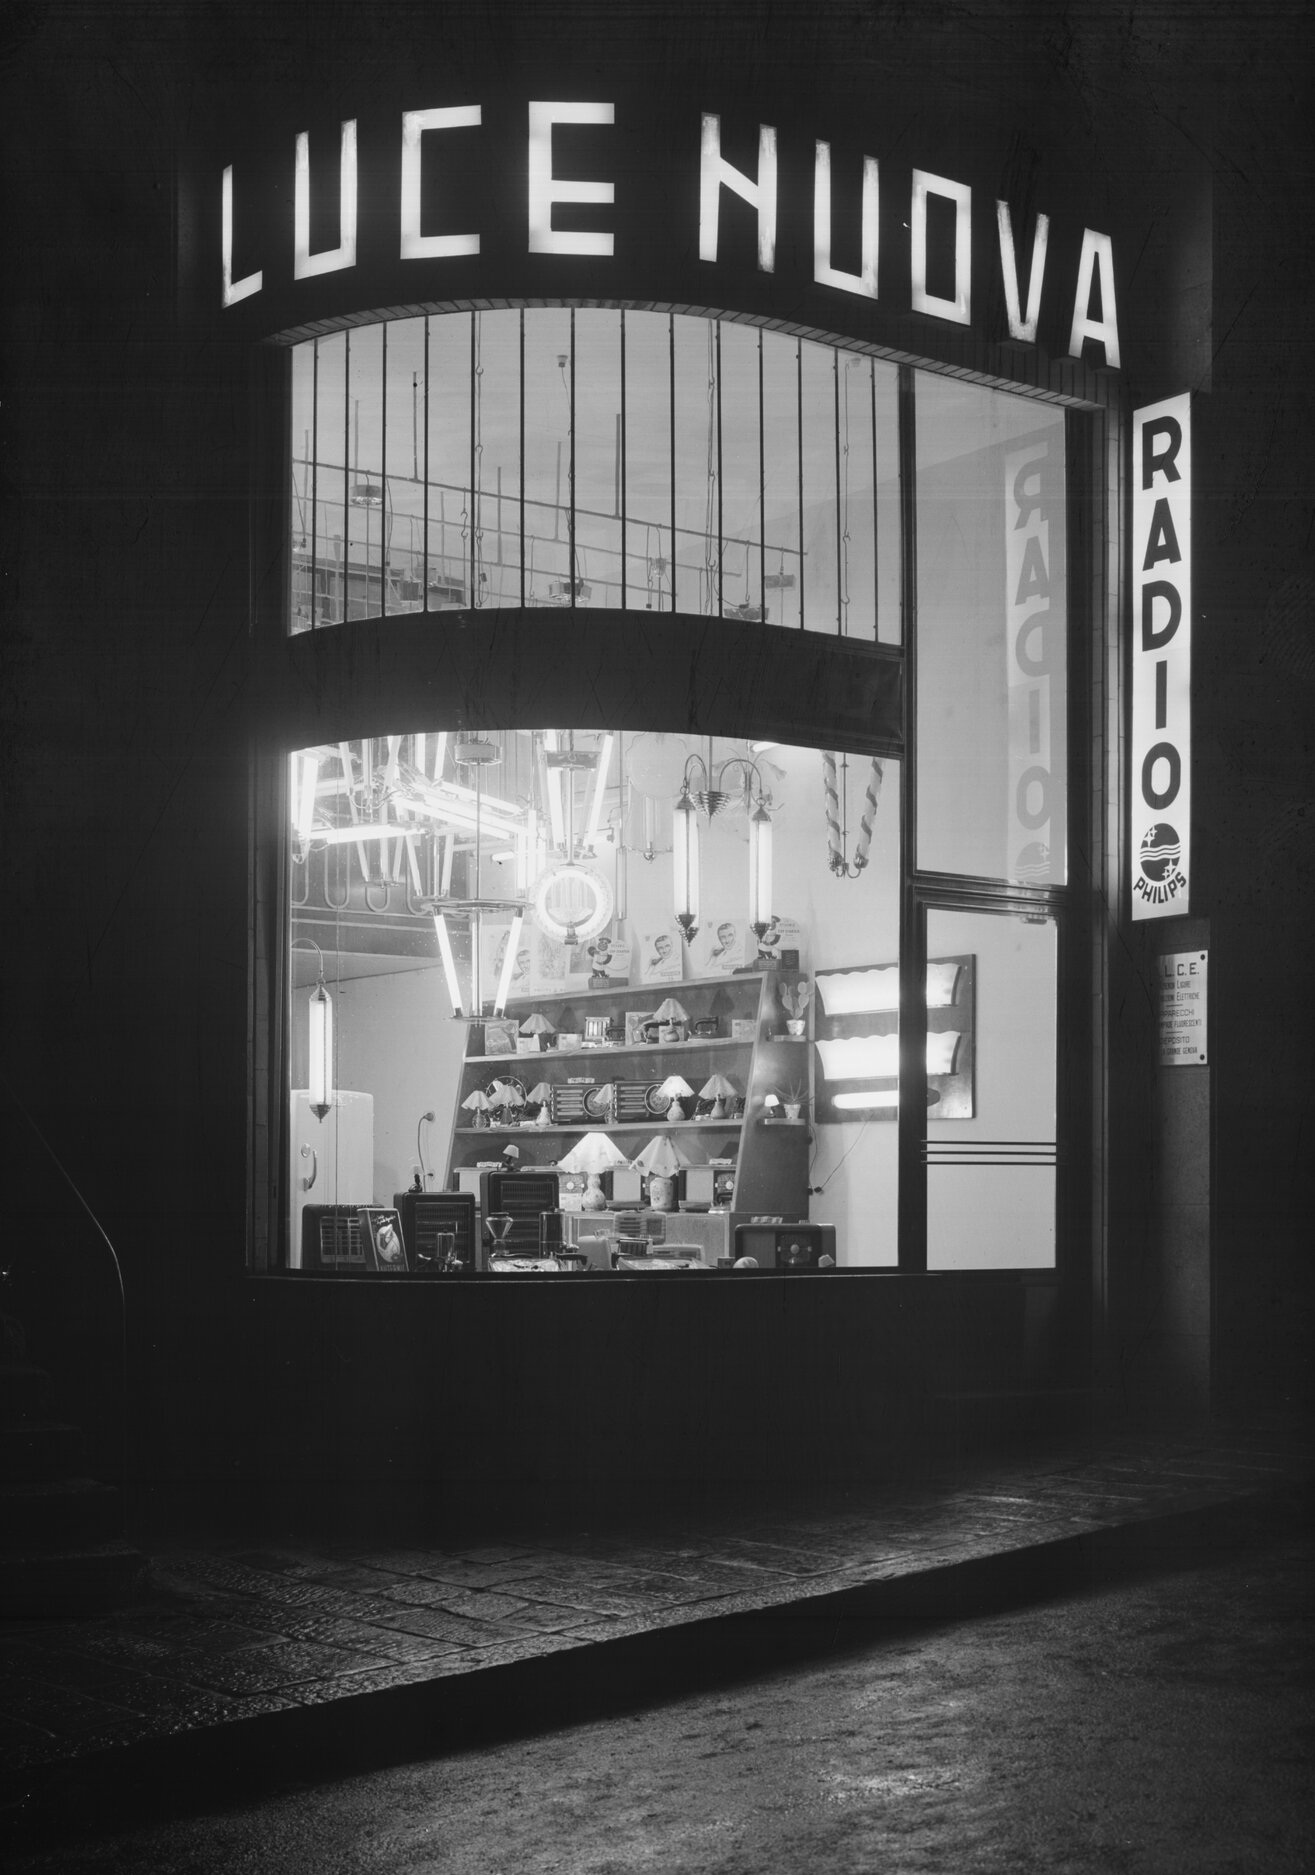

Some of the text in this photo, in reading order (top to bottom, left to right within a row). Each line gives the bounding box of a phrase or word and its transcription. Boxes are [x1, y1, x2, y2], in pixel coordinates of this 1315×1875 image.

[221, 101, 1121, 370] LUCE NUOVA
[1141, 415, 1182, 811] RADIO
[1133, 871, 1187, 904] PHILIPS
